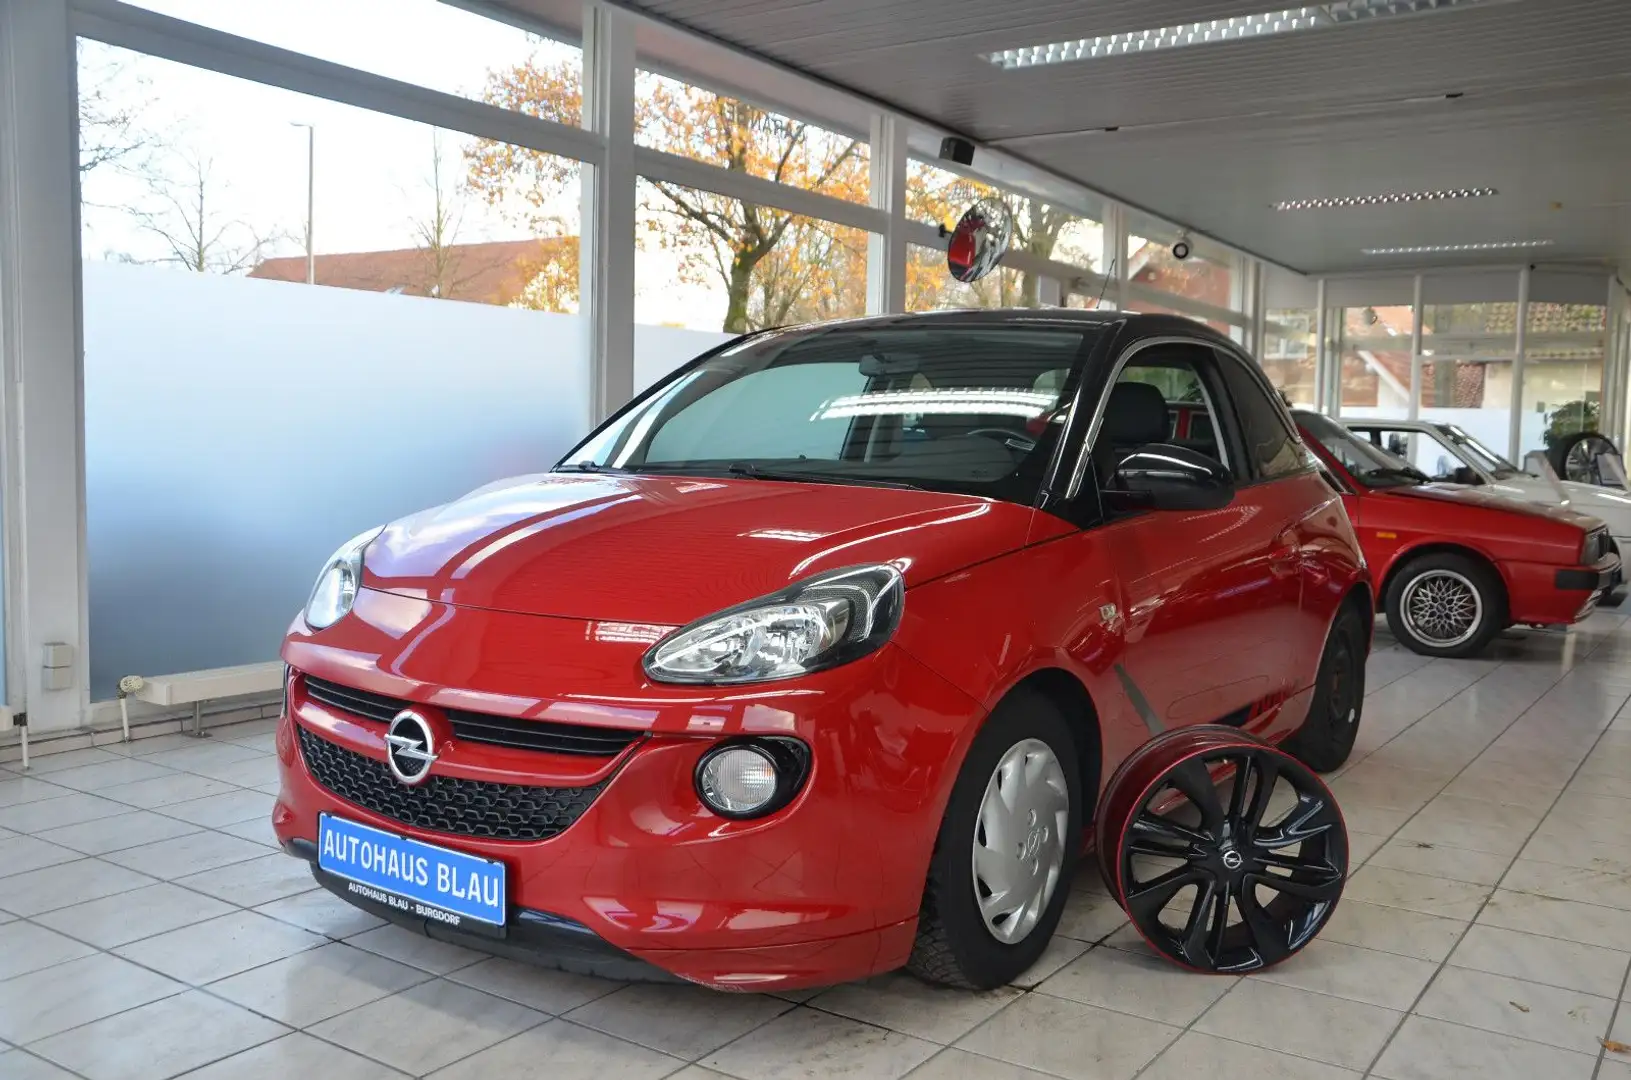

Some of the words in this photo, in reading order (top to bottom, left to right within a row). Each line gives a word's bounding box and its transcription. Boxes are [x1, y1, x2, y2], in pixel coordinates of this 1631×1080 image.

[324, 829, 428, 887] AUTOHAUS
[437, 863, 499, 907] BLAU
[348, 882, 387, 902] AUTOHAUS
[388, 895, 409, 910] BLAU
[416, 904, 461, 925] BURGDORF
